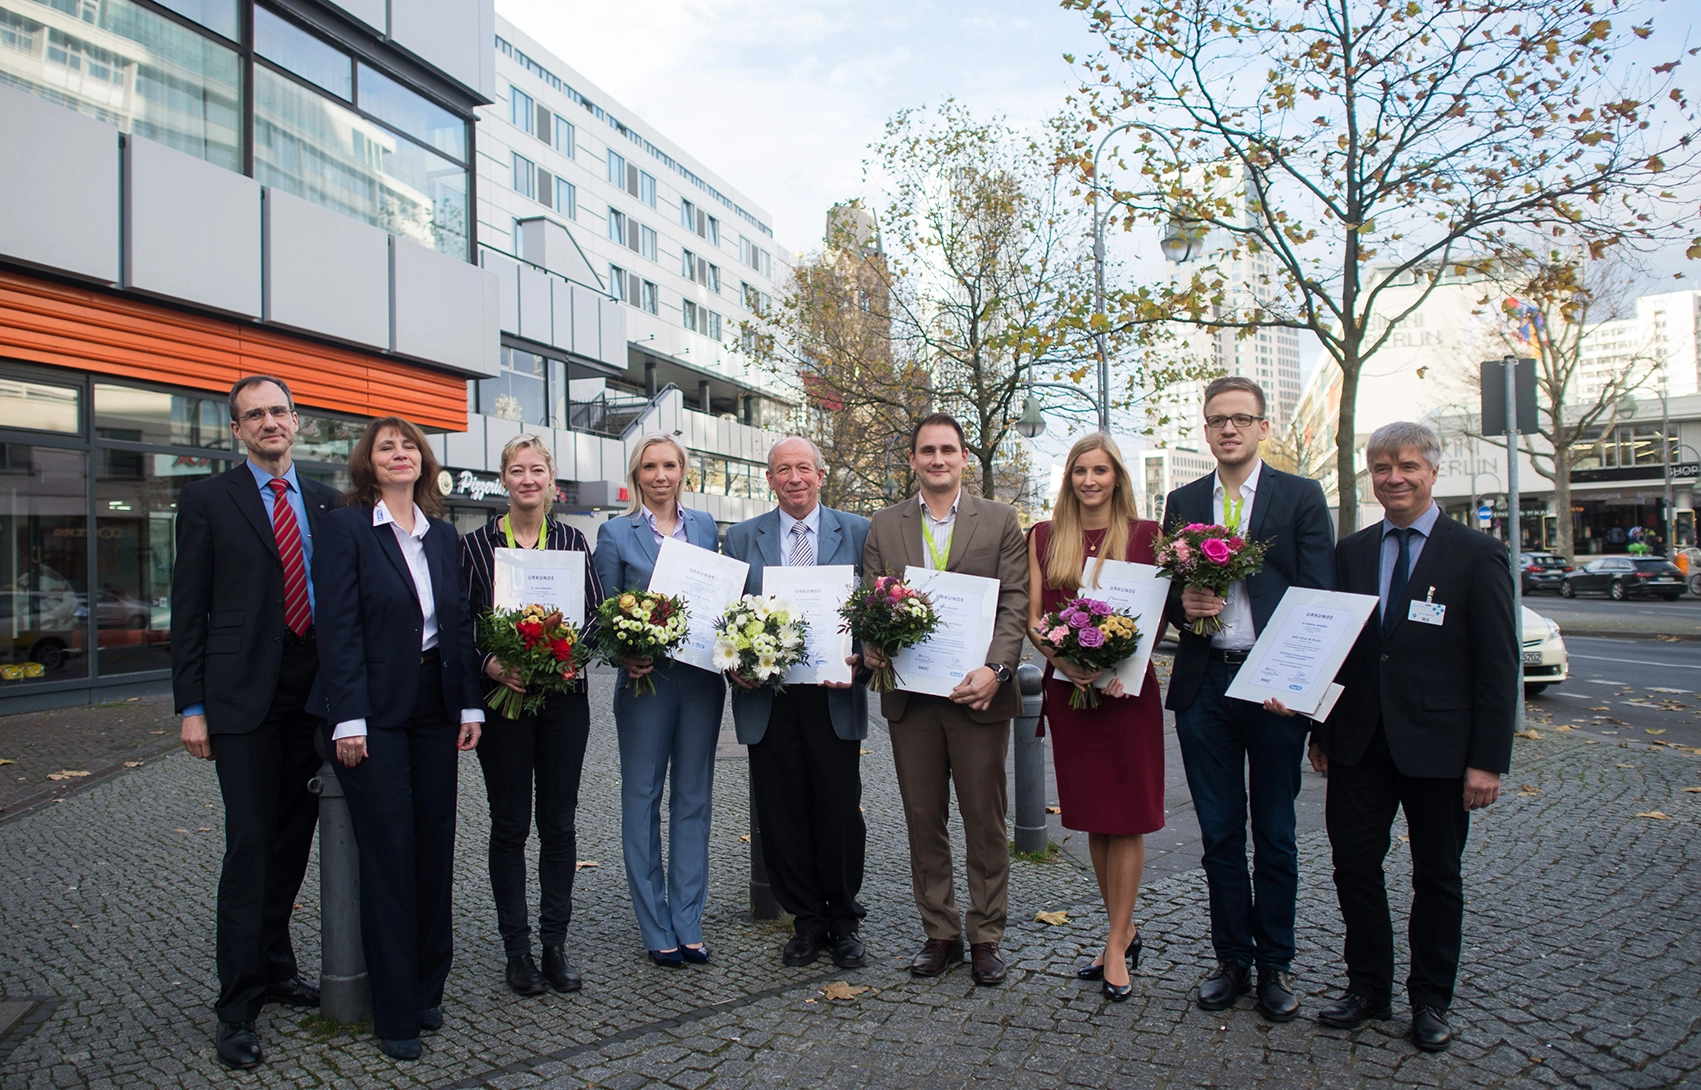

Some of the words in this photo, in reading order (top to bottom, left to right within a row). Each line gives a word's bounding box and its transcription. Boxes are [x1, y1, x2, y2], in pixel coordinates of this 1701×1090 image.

[1438, 457, 1498, 478] ERLIN
[1669, 465, 1699, 476] SHOP
[1110, 585, 1136, 595] URKUNDE
[936, 594, 964, 602] URKUNDE
[1306, 611, 1334, 621] URKUNDE
